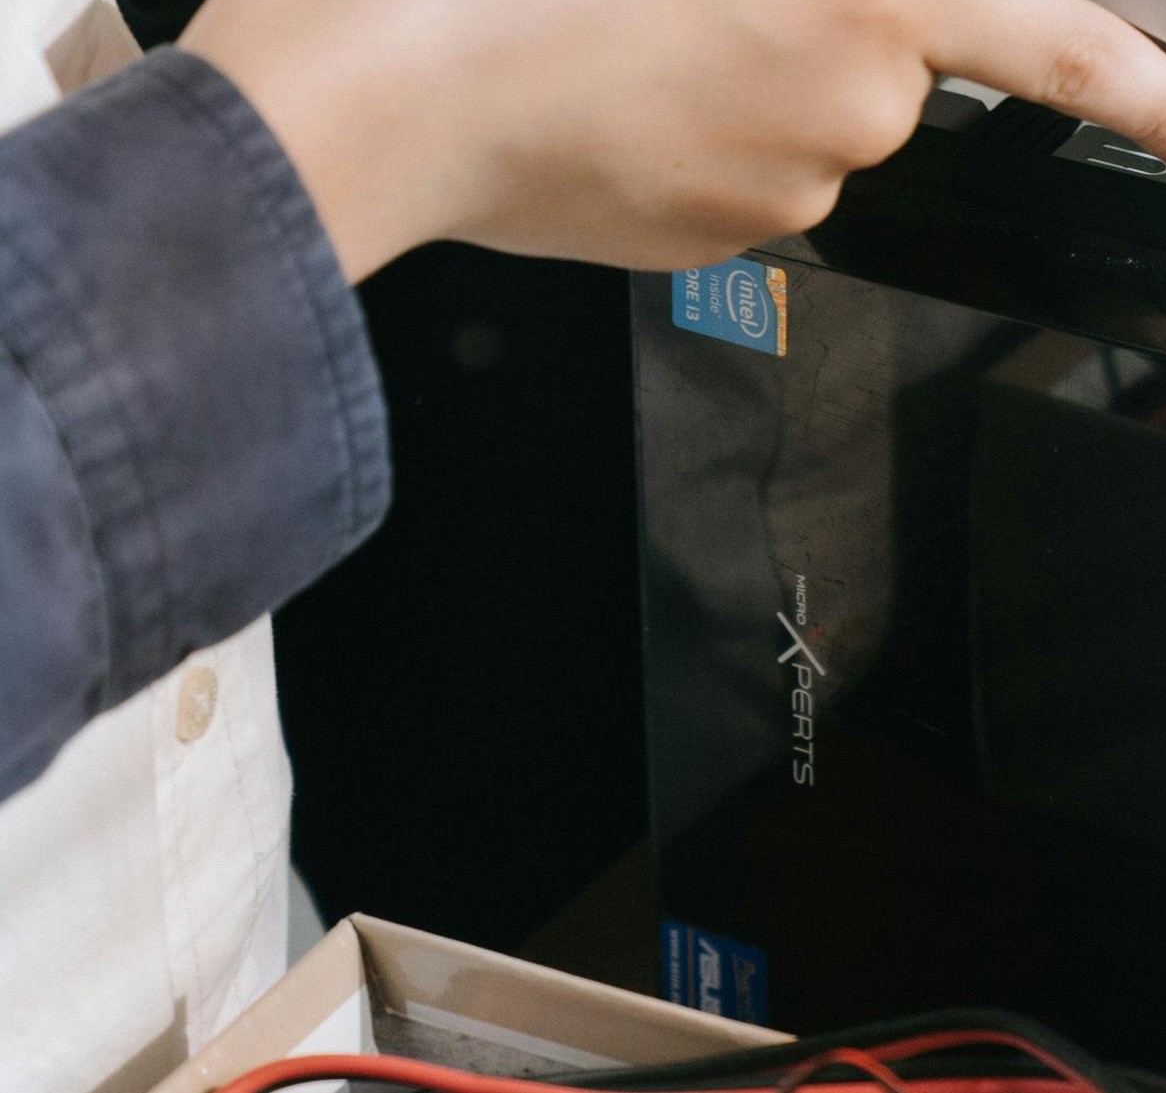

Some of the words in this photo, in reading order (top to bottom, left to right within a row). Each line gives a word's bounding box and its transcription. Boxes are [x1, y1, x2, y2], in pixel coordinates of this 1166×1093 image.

[686, 268, 700, 302] ORE
[739, 280, 759, 327] intel
[686, 305, 700, 321] i3
[796, 574, 806, 626] MICRO
